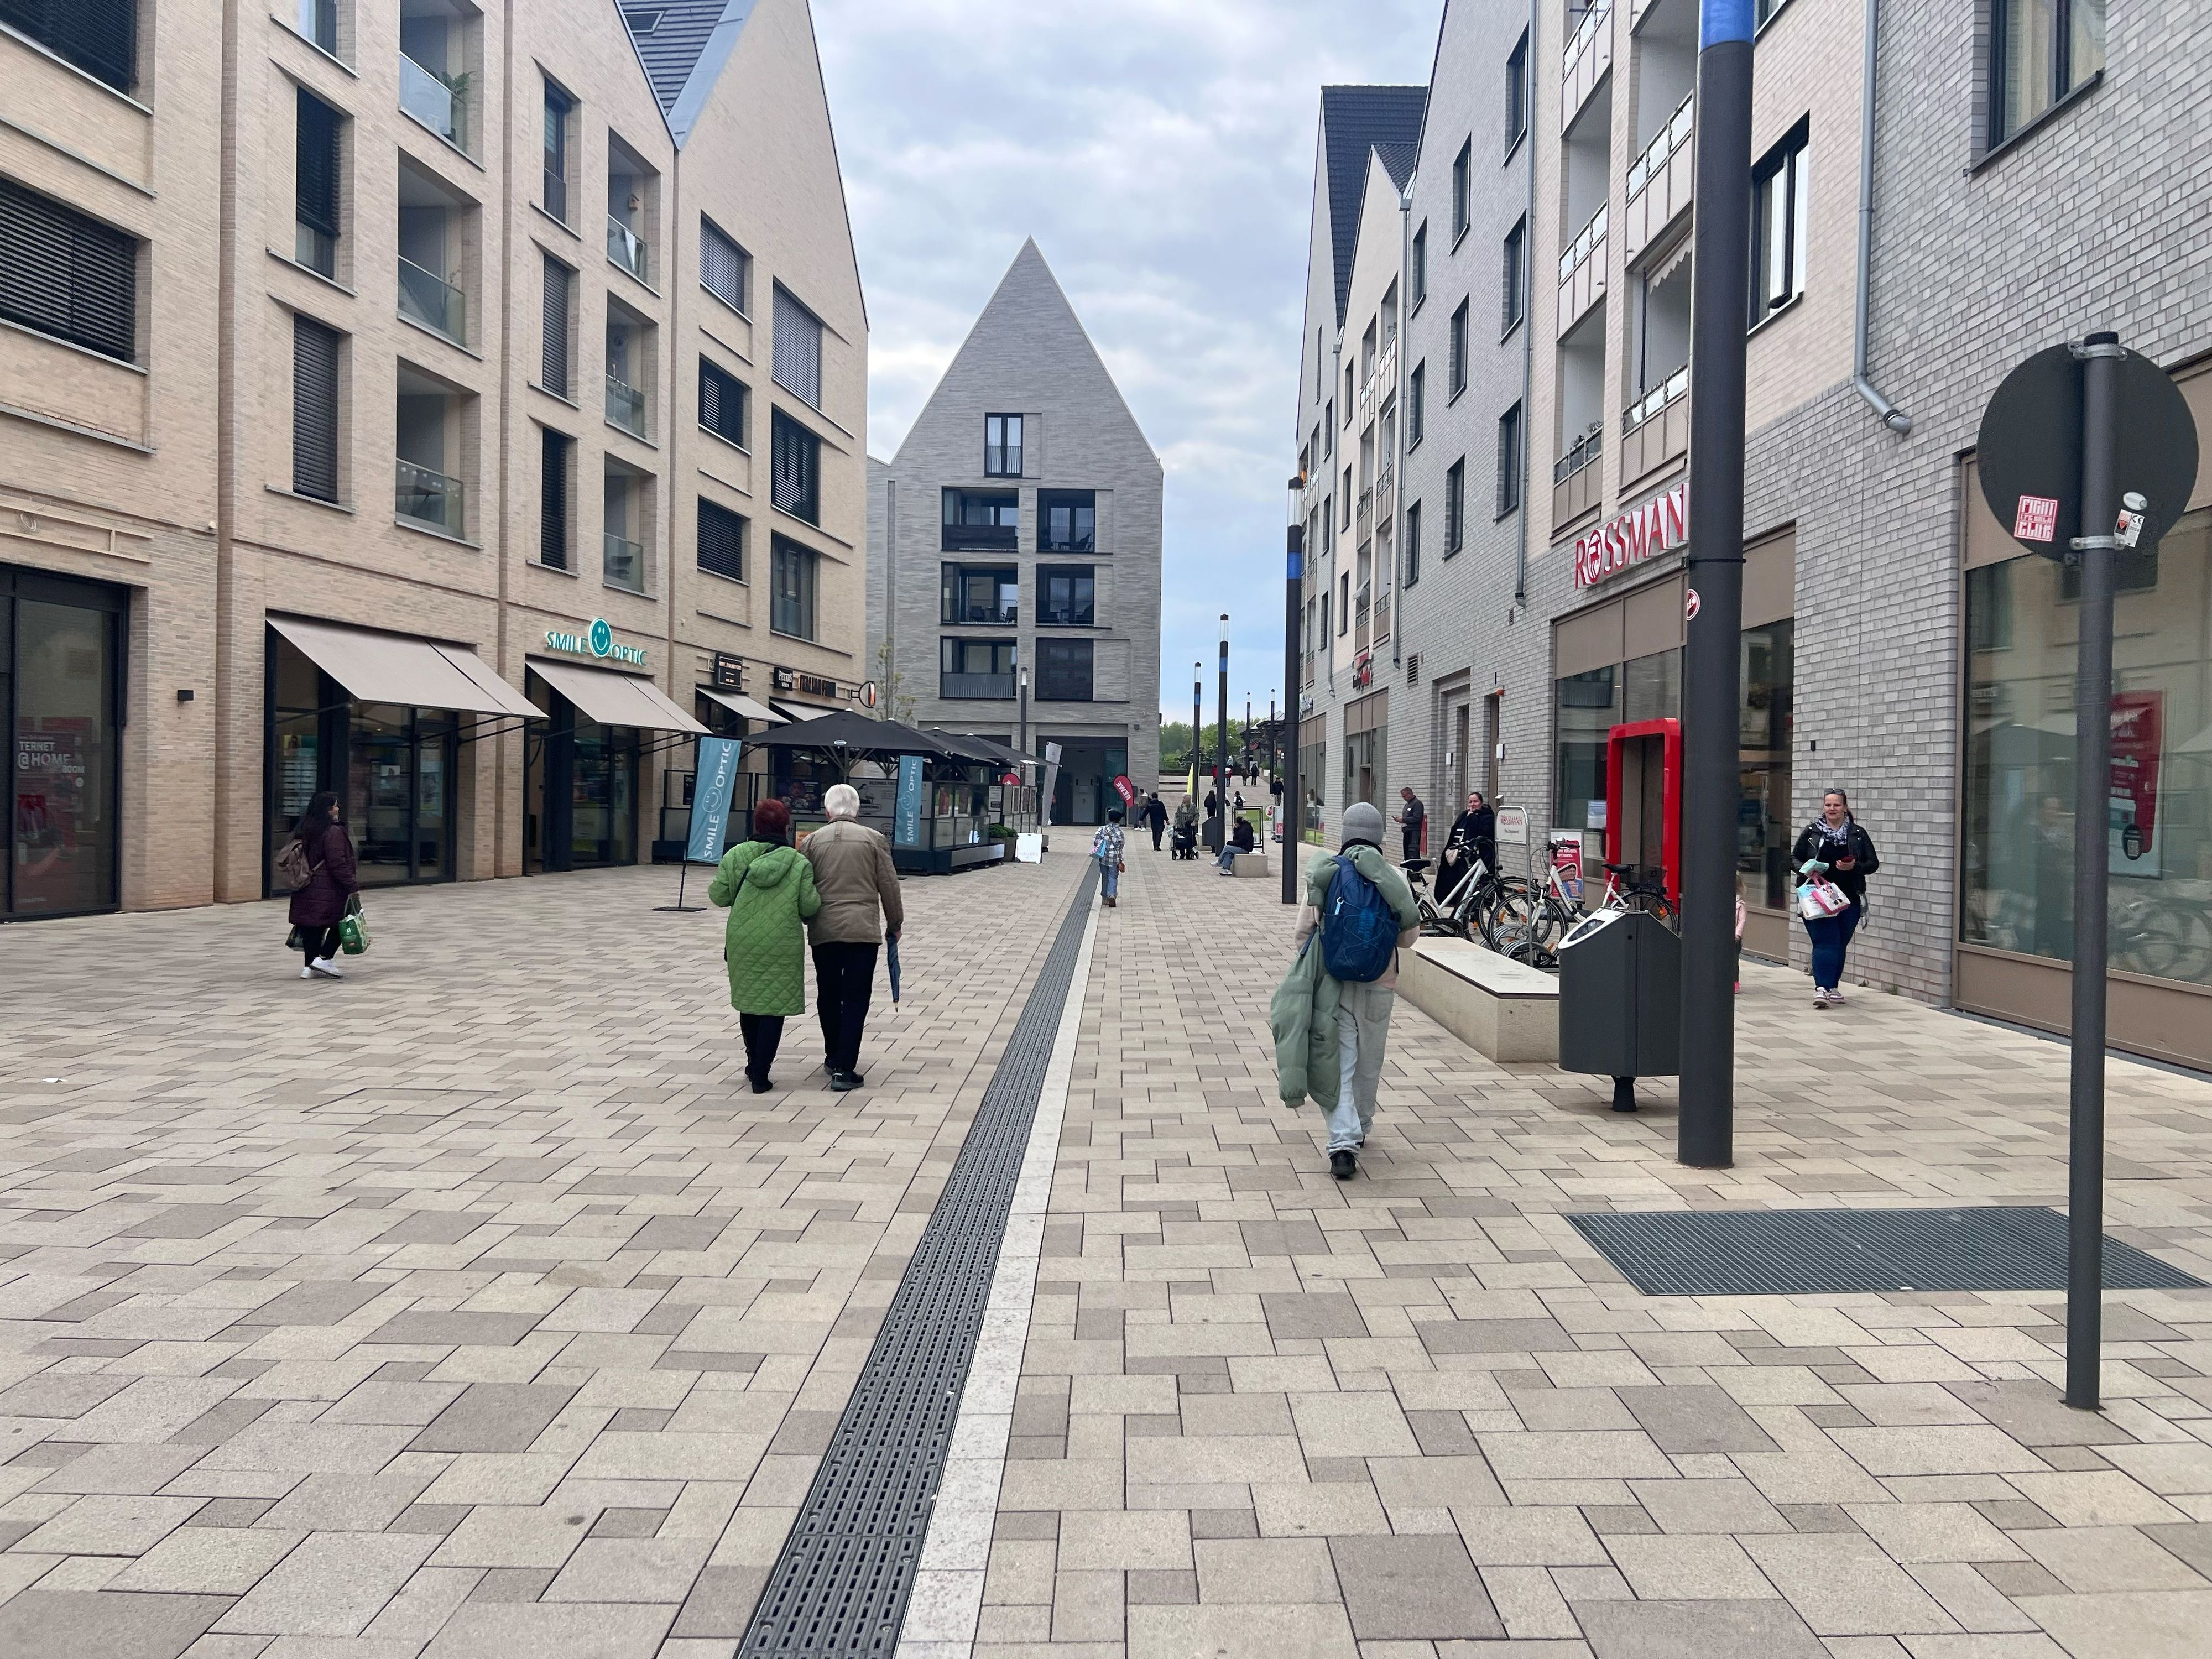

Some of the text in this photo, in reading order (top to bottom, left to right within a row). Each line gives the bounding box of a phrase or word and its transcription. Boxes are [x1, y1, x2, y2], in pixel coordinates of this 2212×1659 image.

[1575, 483, 1689, 589] ROSSMAN
[545, 630, 648, 666] SMILE OPTIC
[704, 742, 732, 858] SMILE OPTIC
[909, 759, 917, 792] OPTIC
